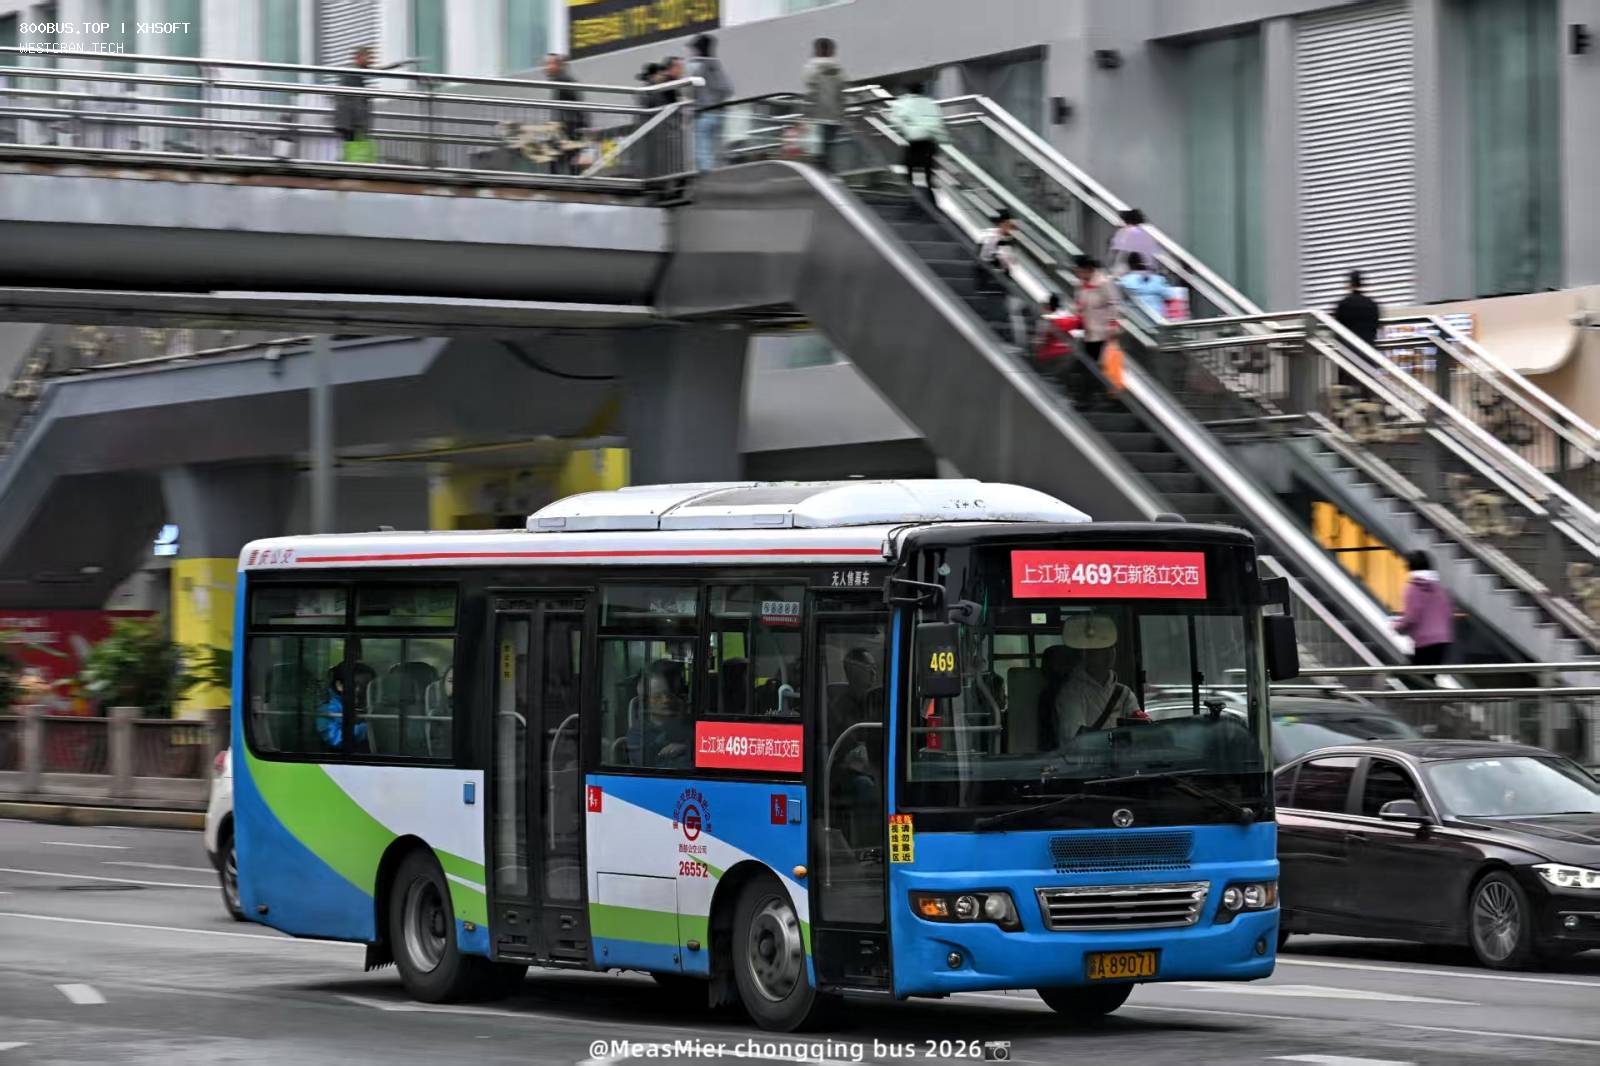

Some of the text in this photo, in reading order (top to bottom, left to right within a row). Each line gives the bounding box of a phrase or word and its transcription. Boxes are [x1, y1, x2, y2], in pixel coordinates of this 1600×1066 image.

[247, 549, 294, 566] 重庆公交
[930, 651, 955, 672] 469
[679, 860, 709, 878] 26552
